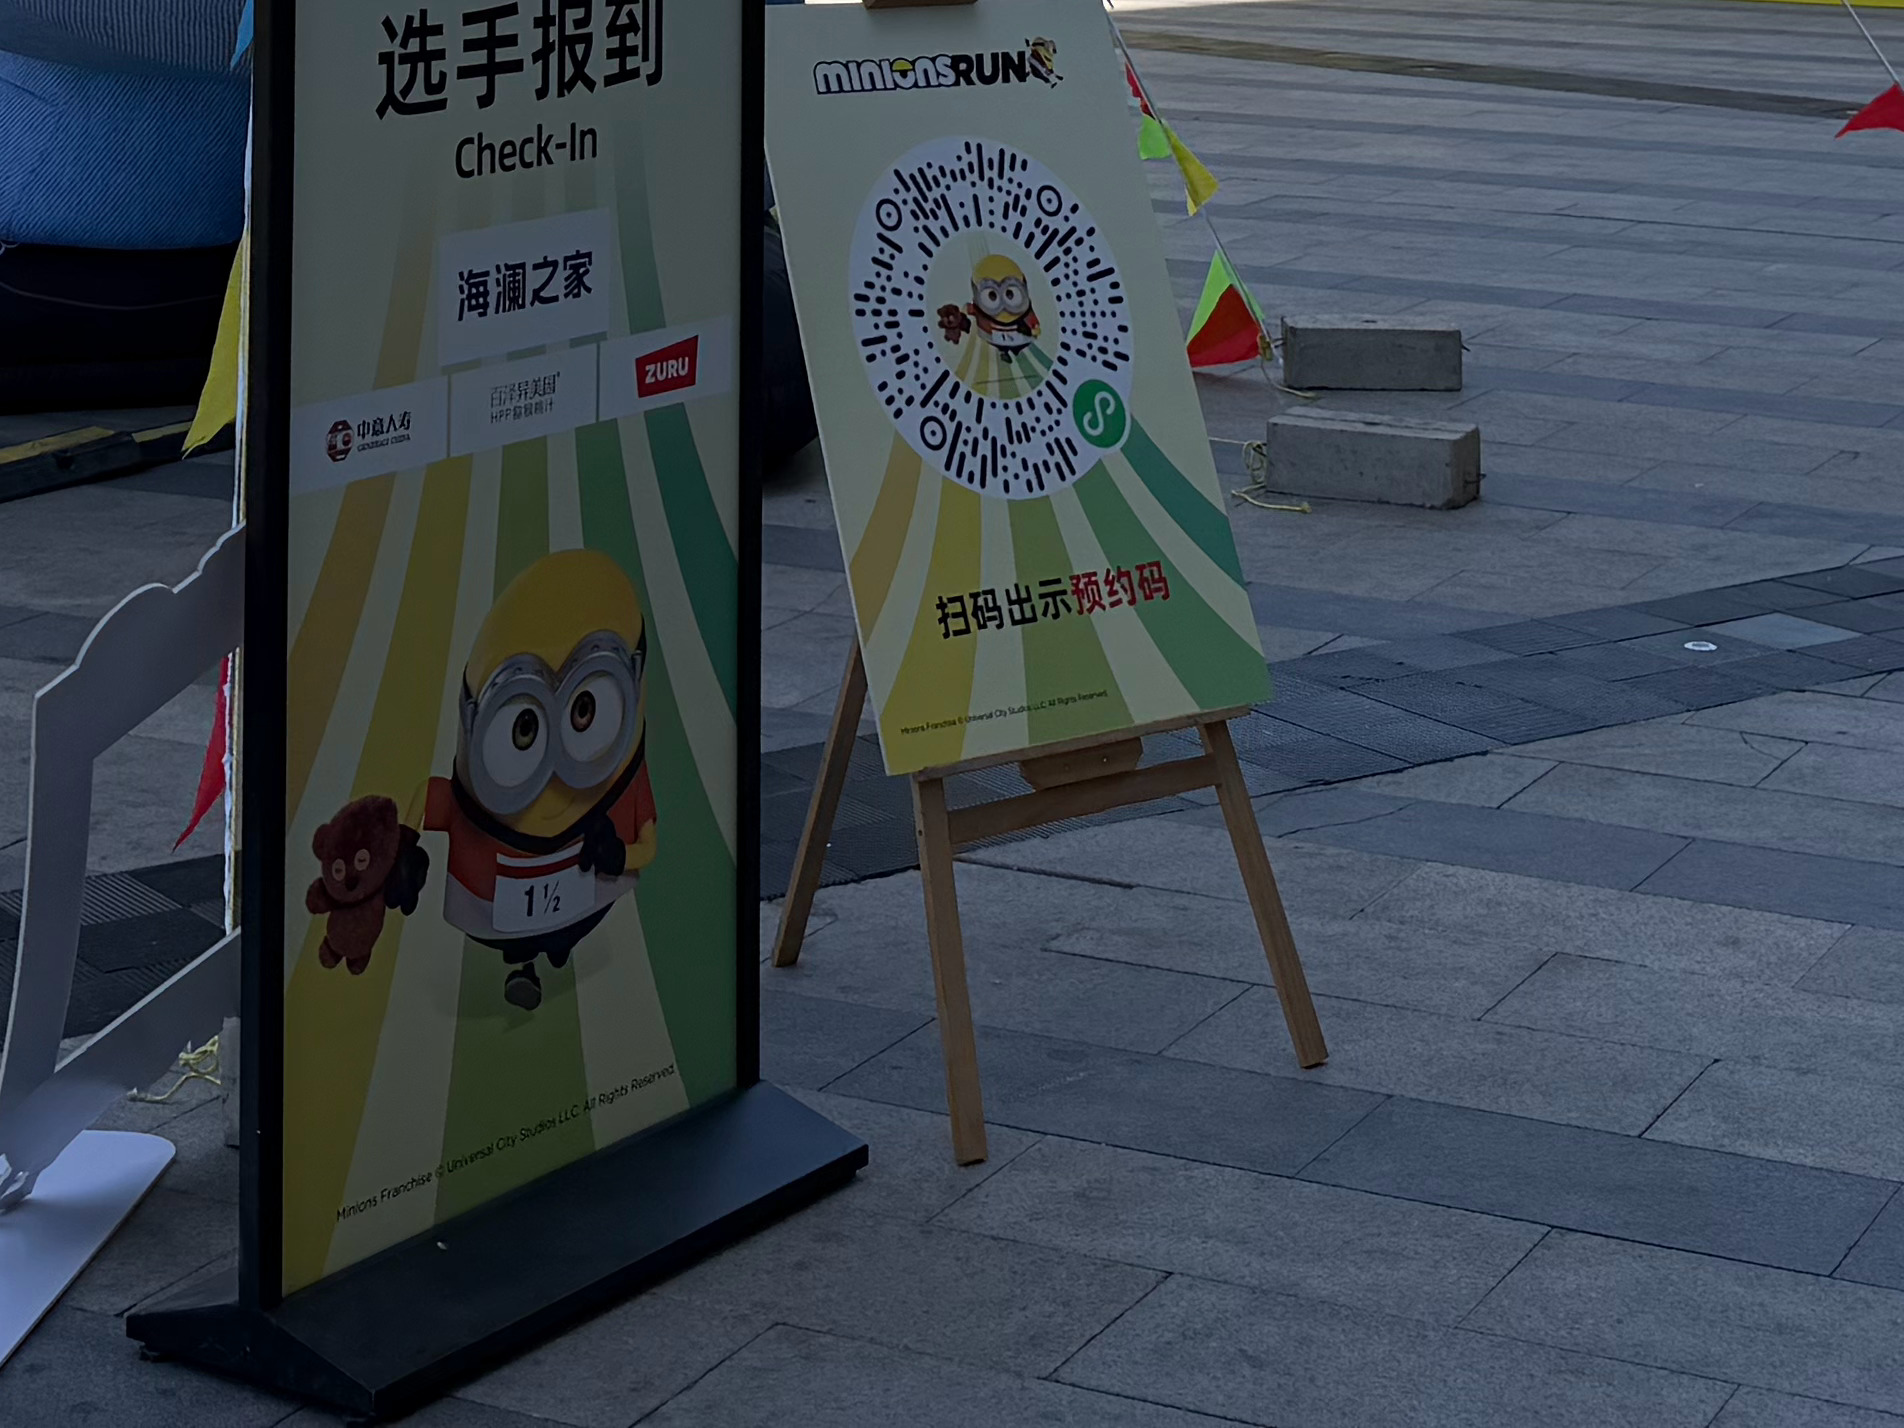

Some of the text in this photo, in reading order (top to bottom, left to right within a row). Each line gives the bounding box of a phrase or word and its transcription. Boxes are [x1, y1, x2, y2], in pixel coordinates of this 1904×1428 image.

[952, 51, 1027, 87] RUN
[456, 123, 598, 178] Check-In
[458, 250, 593, 321] 海澜之家
[644, 356, 689, 384] ZURU
[357, 411, 412, 439] 中意人寿
[936, 560, 1170, 639] 扫码出示预约码
[337, 1195, 378, 1223] Minions
[381, 1172, 432, 1201] Franchise
[447, 1143, 495, 1174] Universal
[496, 1133, 518, 1153] City
[520, 1116, 556, 1143] Studios
[598, 1085, 629, 1107] Rights
